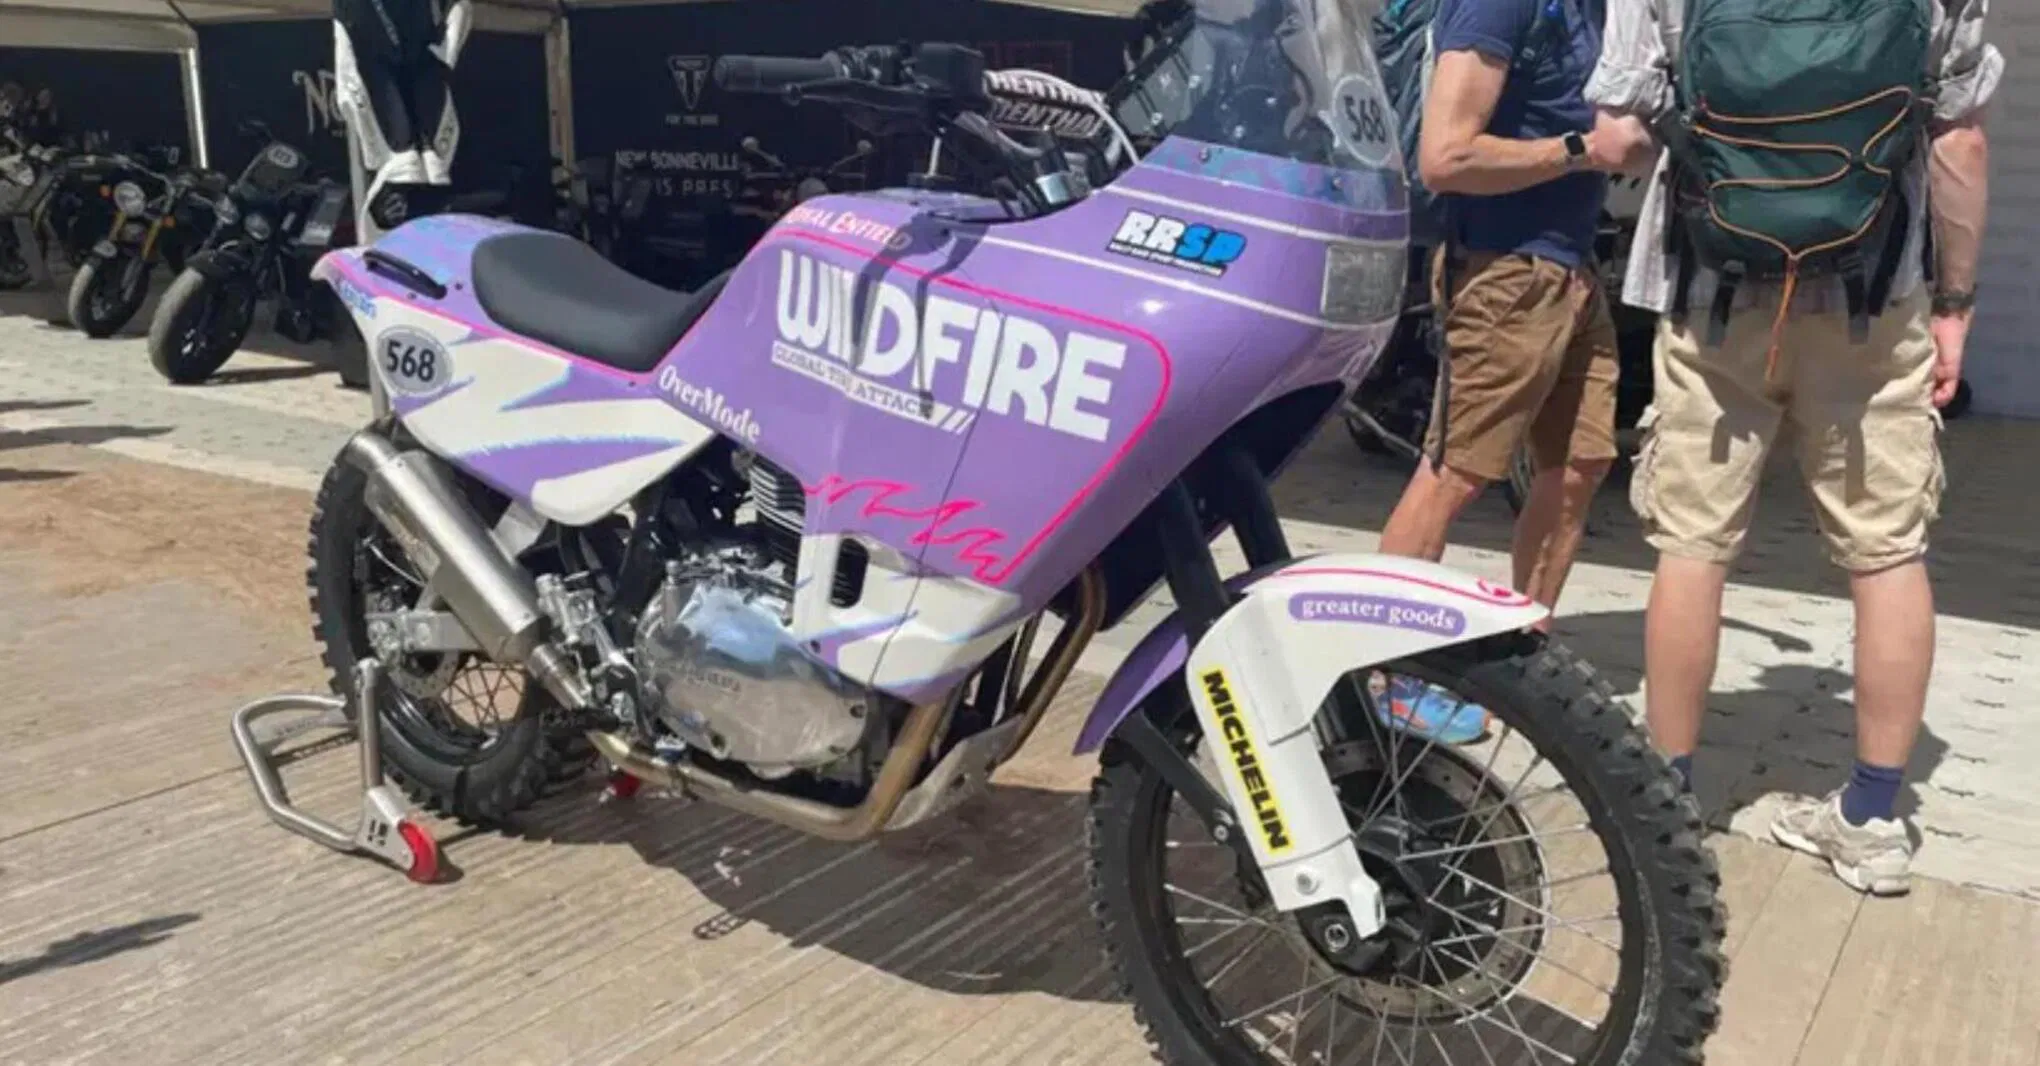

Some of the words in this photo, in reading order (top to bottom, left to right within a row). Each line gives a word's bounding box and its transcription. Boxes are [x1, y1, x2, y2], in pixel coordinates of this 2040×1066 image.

[1342, 94, 1387, 144] 568
[385, 338, 436, 383] 568
[777, 249, 1126, 442] WILDFIRE
[660, 363, 762, 444] OverMode
[1302, 598, 1385, 619] greater
[1389, 605, 1457, 630] goods
[1203, 670, 1290, 850] MICHELIN
